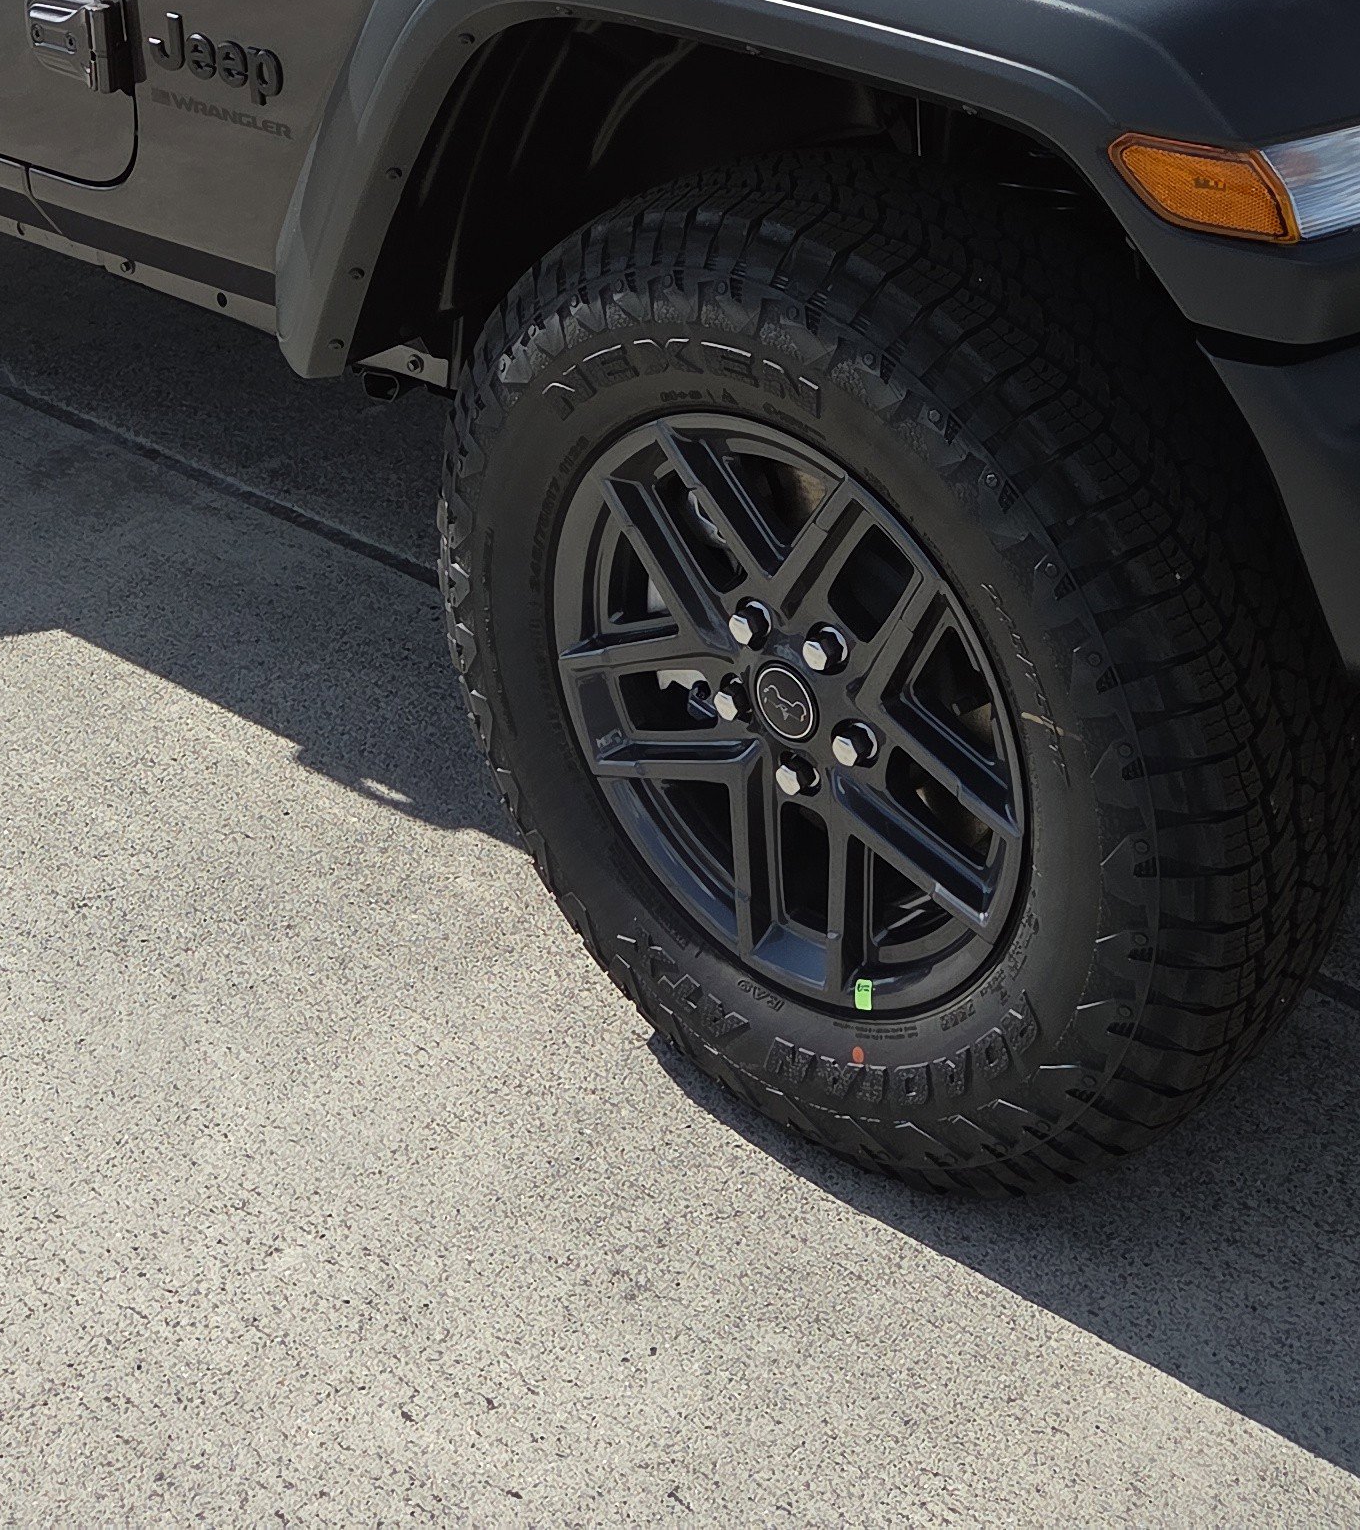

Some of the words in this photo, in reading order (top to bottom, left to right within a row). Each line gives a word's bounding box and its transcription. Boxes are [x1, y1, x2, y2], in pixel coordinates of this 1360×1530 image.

[148, 11, 284, 107] Jeep
[169, 91, 295, 141] WRANGLER
[542, 337, 822, 422] NEXEN
[763, 988, 1040, 1107] ROADIAN
